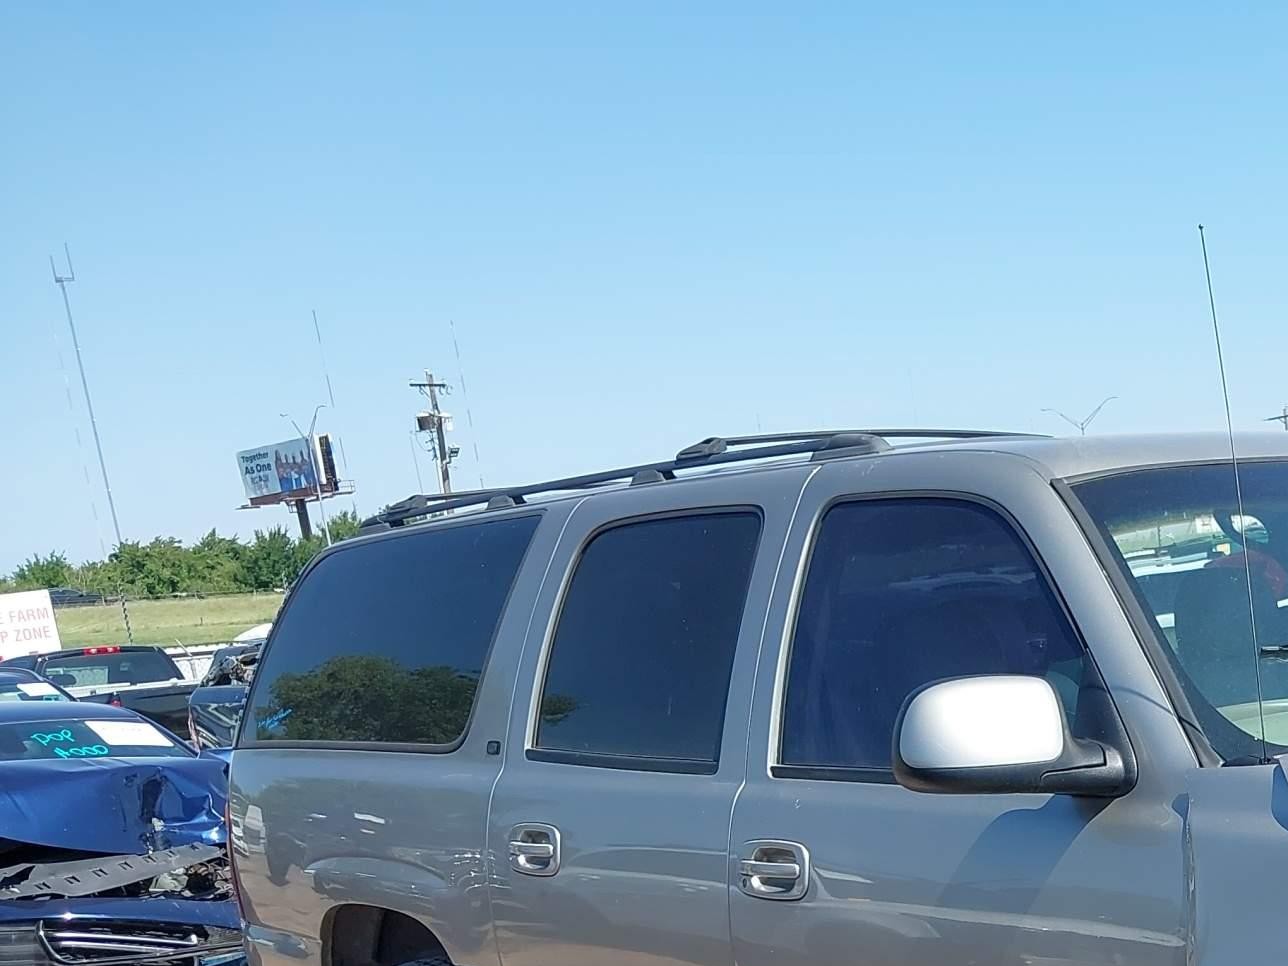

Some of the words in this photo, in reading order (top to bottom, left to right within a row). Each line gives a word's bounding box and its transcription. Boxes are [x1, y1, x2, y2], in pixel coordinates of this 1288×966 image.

[241, 452, 269, 463] Together
[245, 466, 255, 475] As
[256, 463, 272, 473] One
[9, 608, 49, 622] FARM
[13, 626, 52, 642] ZONE
